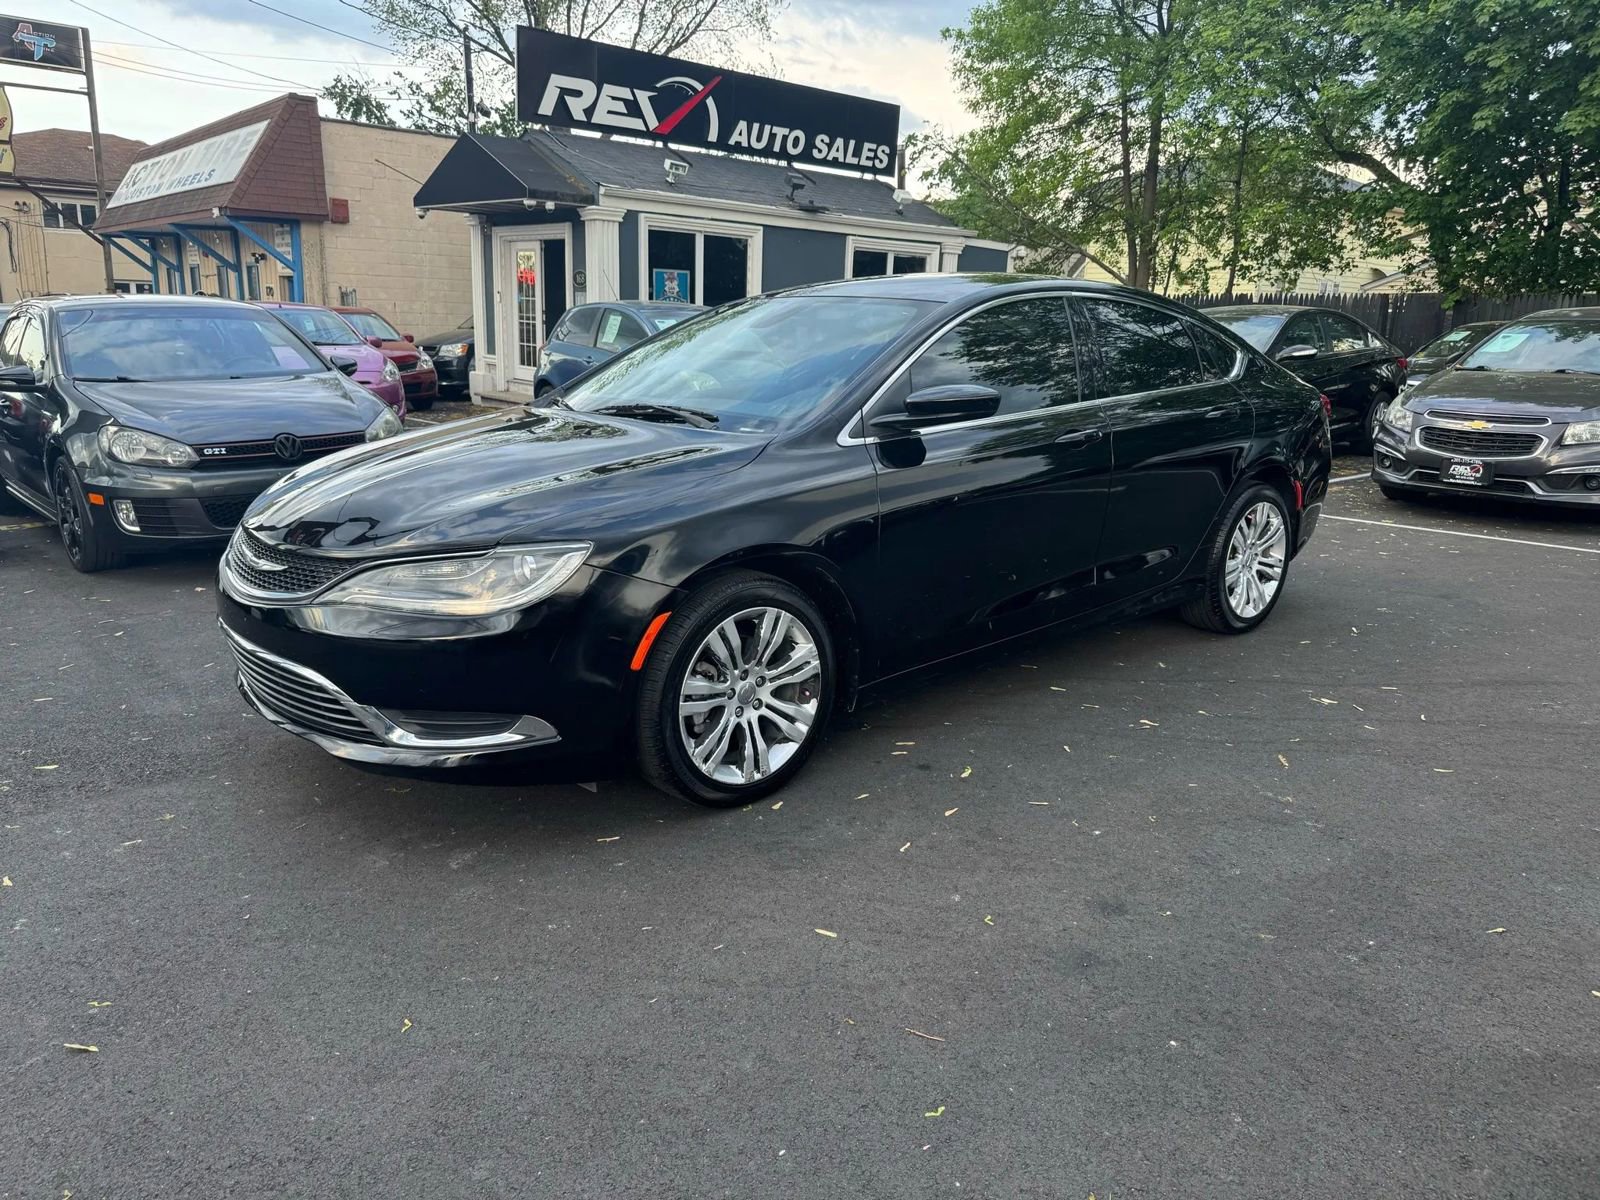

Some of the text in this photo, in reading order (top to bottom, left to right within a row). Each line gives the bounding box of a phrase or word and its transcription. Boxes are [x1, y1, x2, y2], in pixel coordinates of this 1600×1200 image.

[728, 120, 806, 156] AUTO
[812, 134, 890, 169] SALES
[167, 168, 217, 191] WHEELS
[203, 447, 227, 455] GTI
